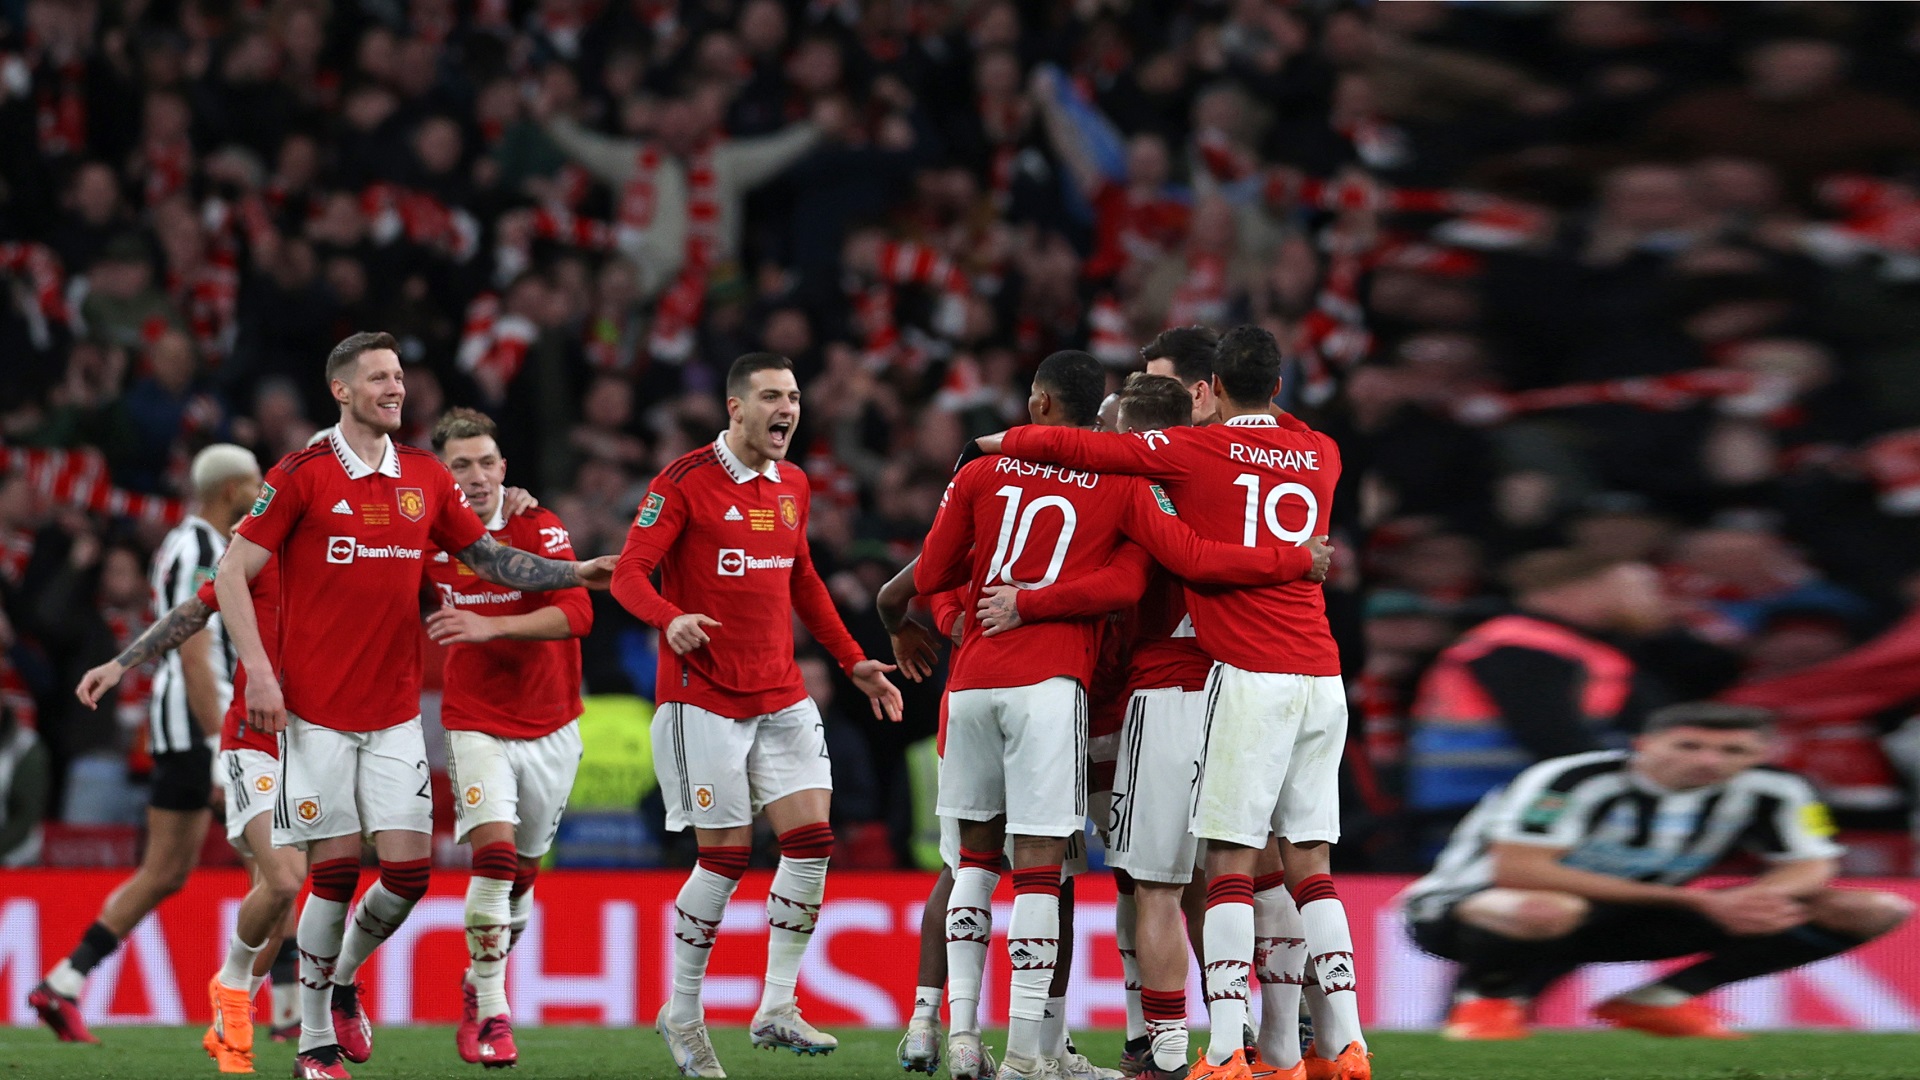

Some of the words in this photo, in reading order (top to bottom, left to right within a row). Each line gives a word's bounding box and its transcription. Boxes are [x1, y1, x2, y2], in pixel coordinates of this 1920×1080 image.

[1229, 442, 1320, 473] R.VARANE
[995, 456, 1099, 489] RASHFORD
[1232, 472, 1319, 549] 19
[985, 484, 1078, 591] 10
[355, 544, 423, 560] TeamViewer
[452, 590, 522, 605] TeamViewer
[949, 923, 983, 932] adidas
[1325, 970, 1353, 980] adidas
